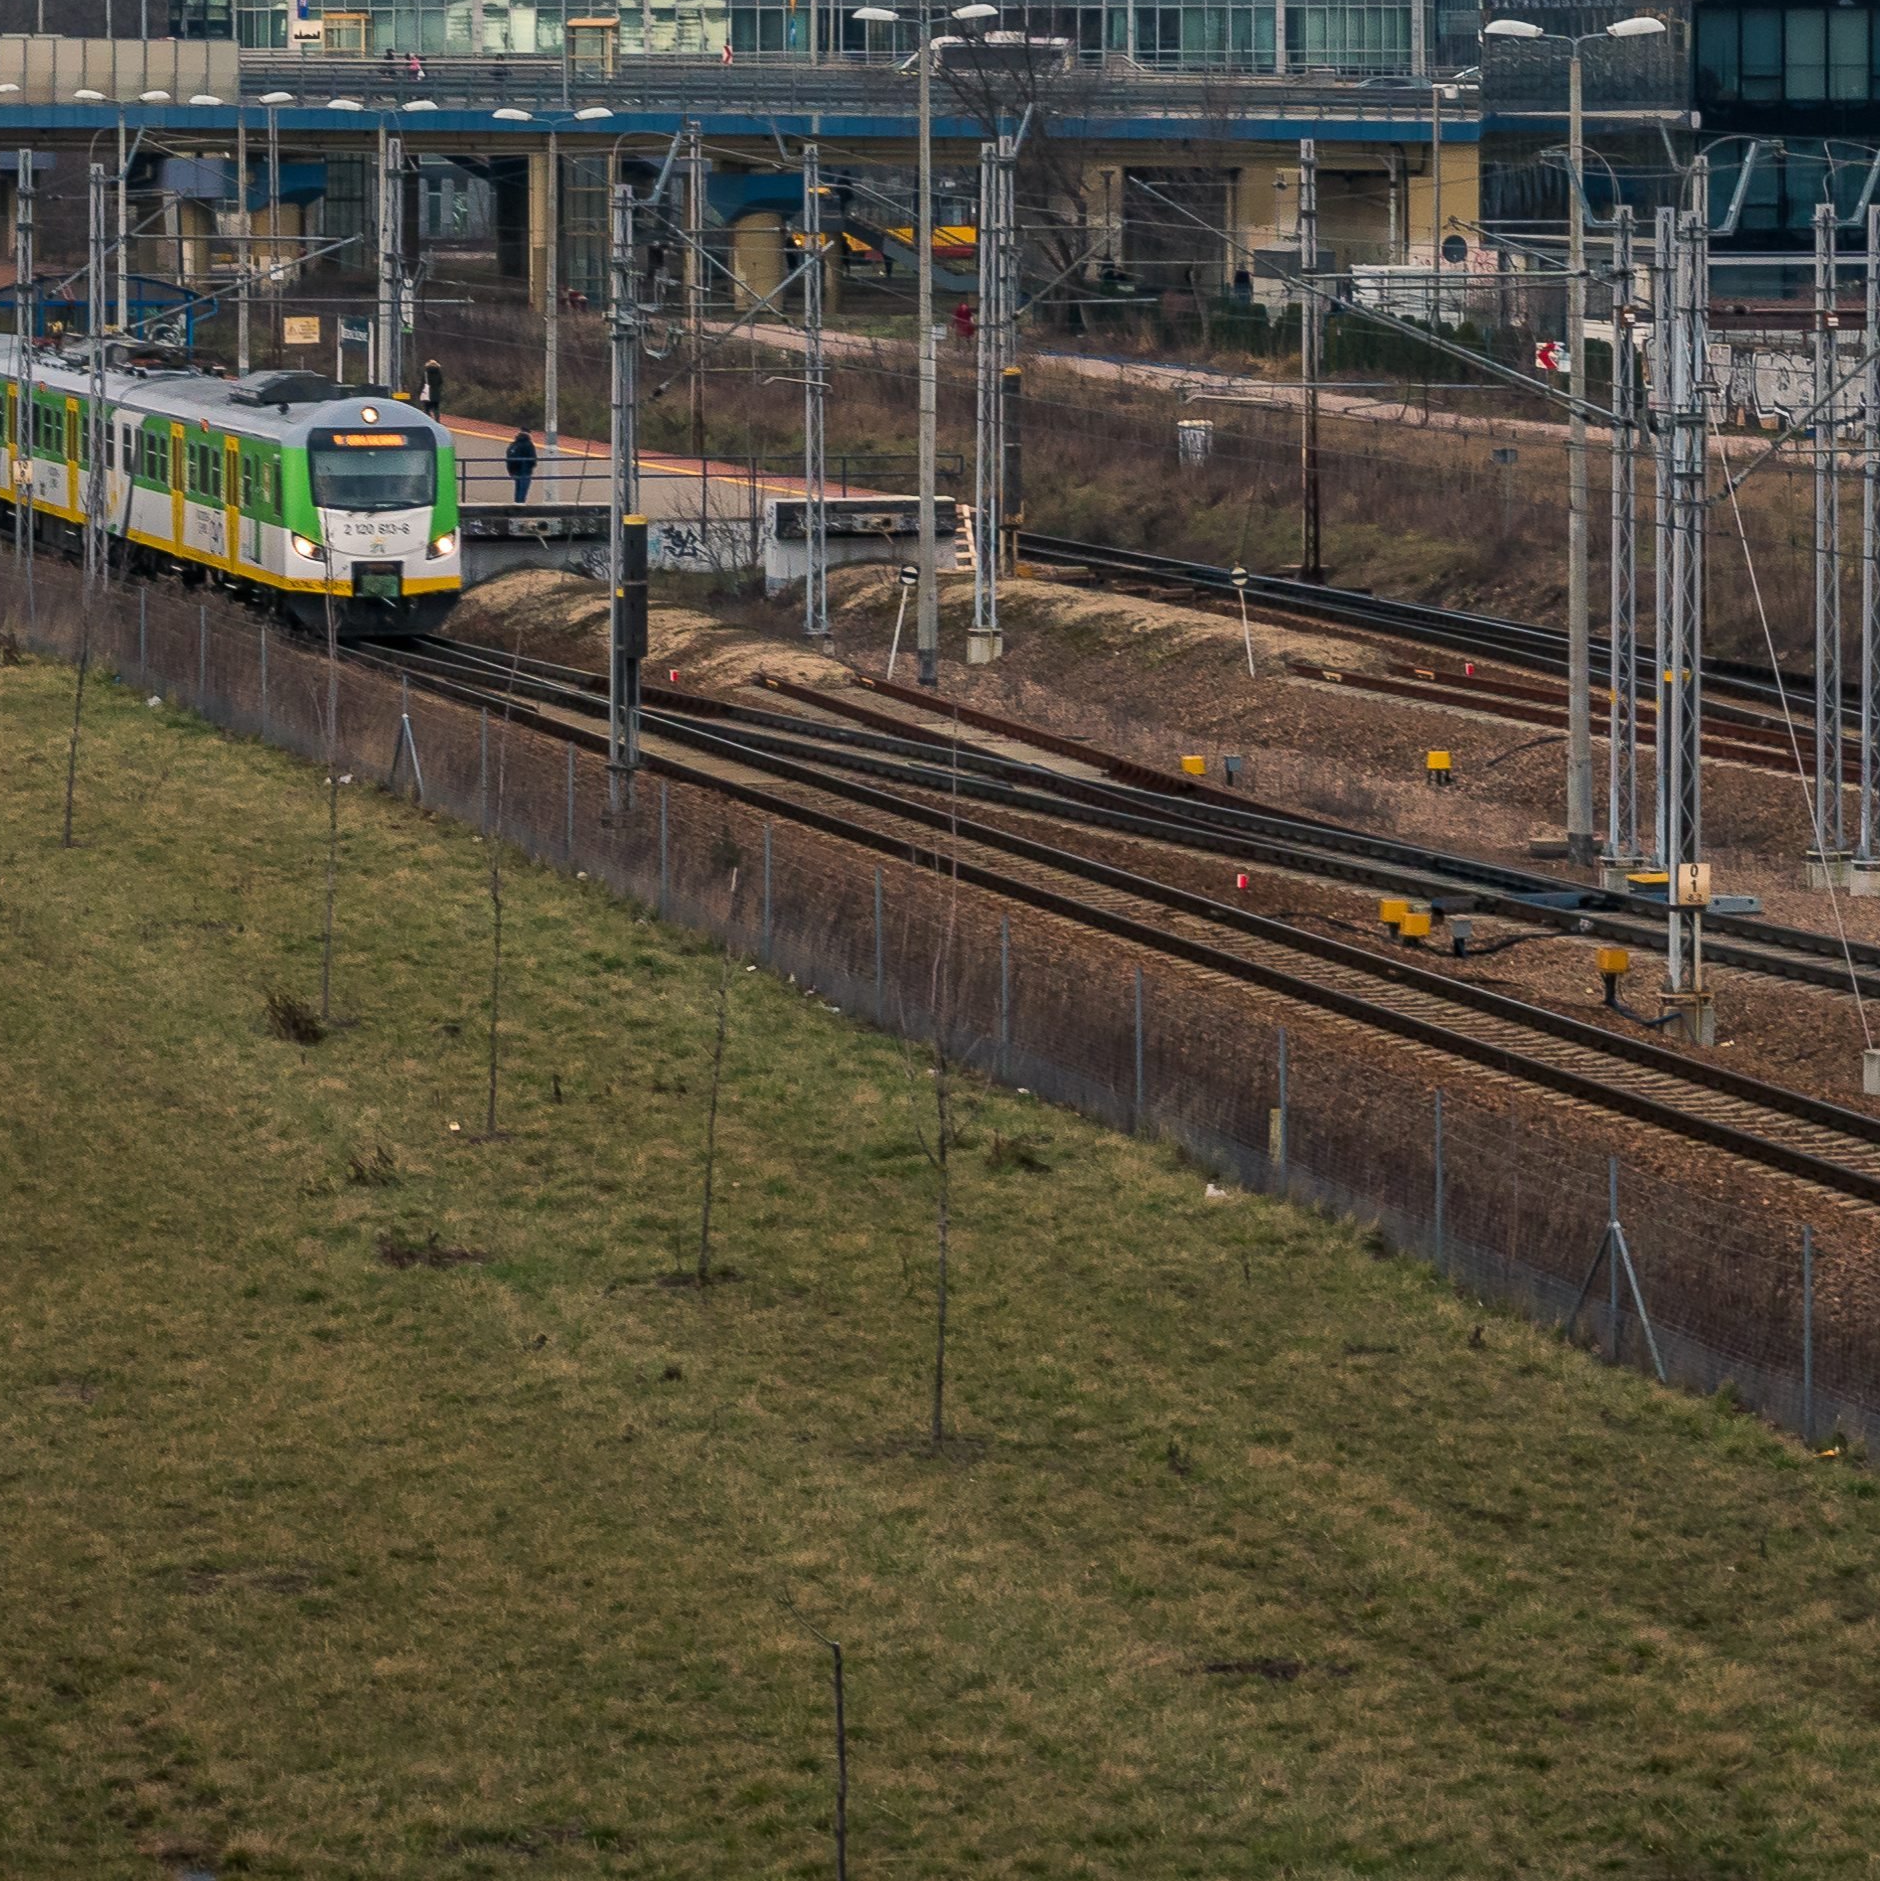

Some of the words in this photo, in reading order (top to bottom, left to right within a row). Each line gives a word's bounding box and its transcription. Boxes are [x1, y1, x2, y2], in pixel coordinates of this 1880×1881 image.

[343, 523, 352, 536] 2
[355, 523, 376, 535] 120
[1690, 864, 1699, 878] 0
[1691, 880, 1697, 893] 1
